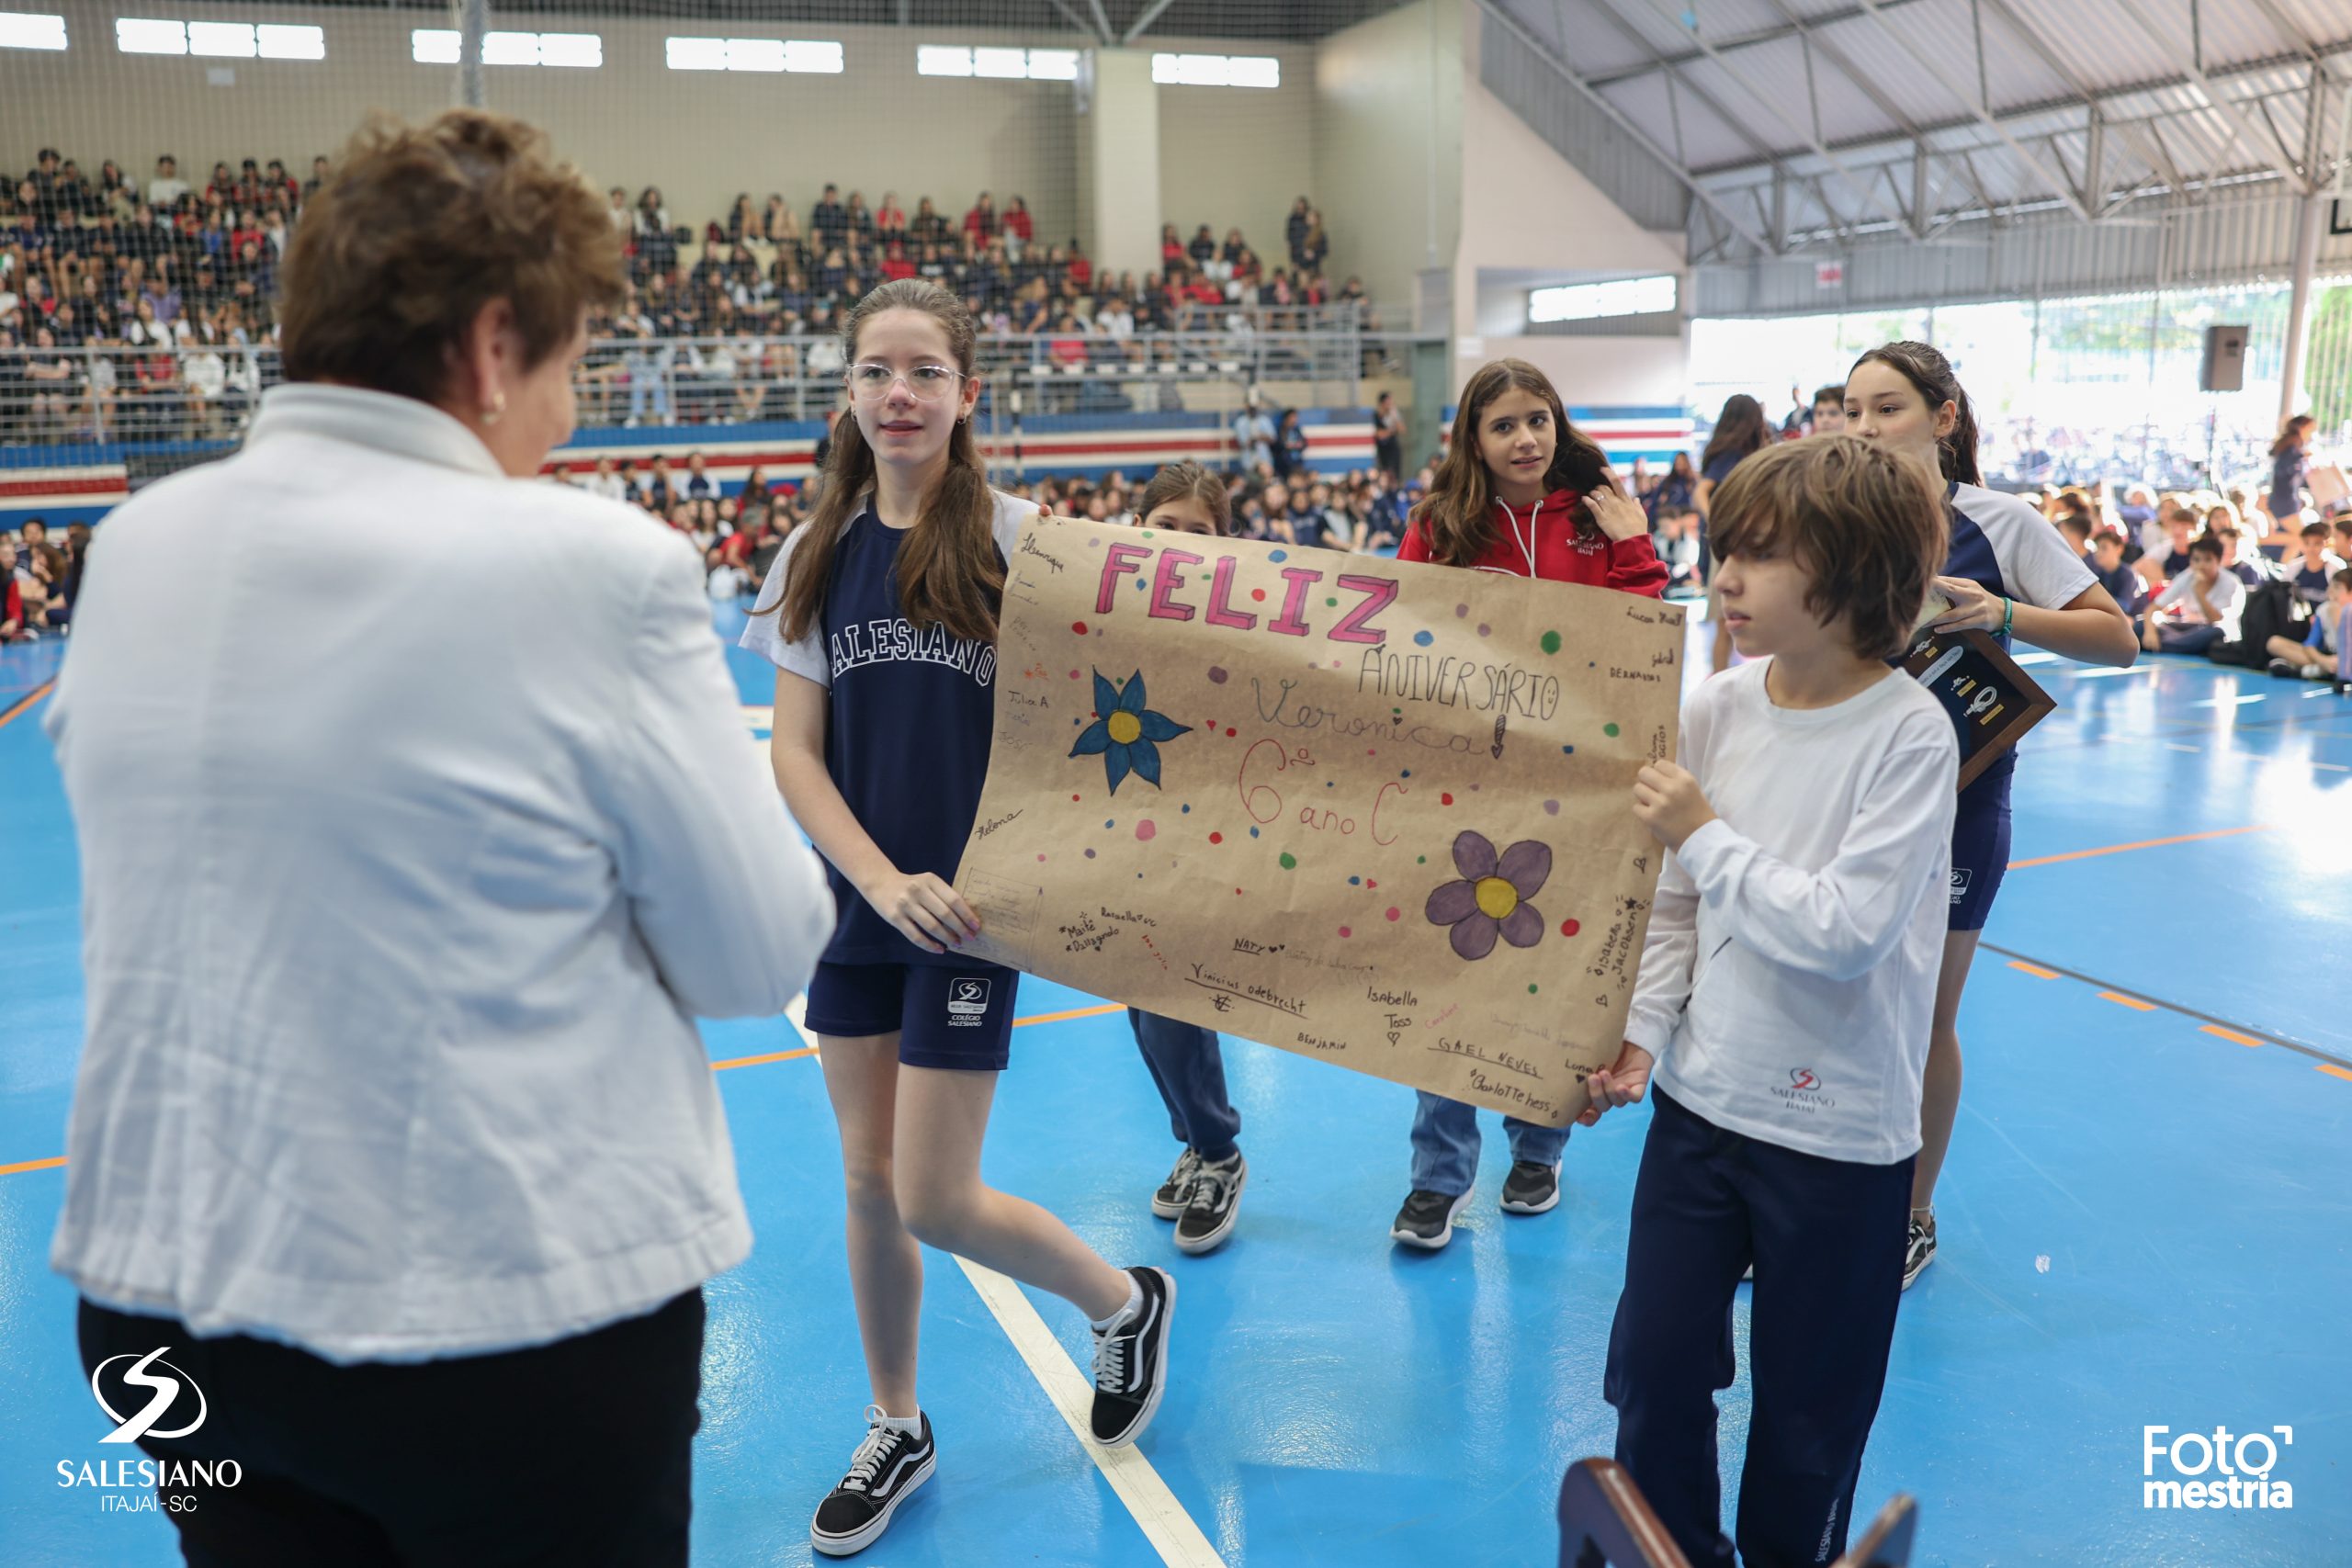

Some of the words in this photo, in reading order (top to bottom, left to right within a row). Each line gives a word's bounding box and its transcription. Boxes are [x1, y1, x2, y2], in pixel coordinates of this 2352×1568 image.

[1095, 542, 1400, 645] FELIZ
[831, 617, 997, 687] ALESIANO
[1299, 806, 1356, 835] ano
[1371, 782, 1409, 846] C
[1384, 1013, 1413, 1029] Toss
[1438, 1037, 1486, 1058] GAEL
[1498, 1051, 1540, 1077] NEVES
